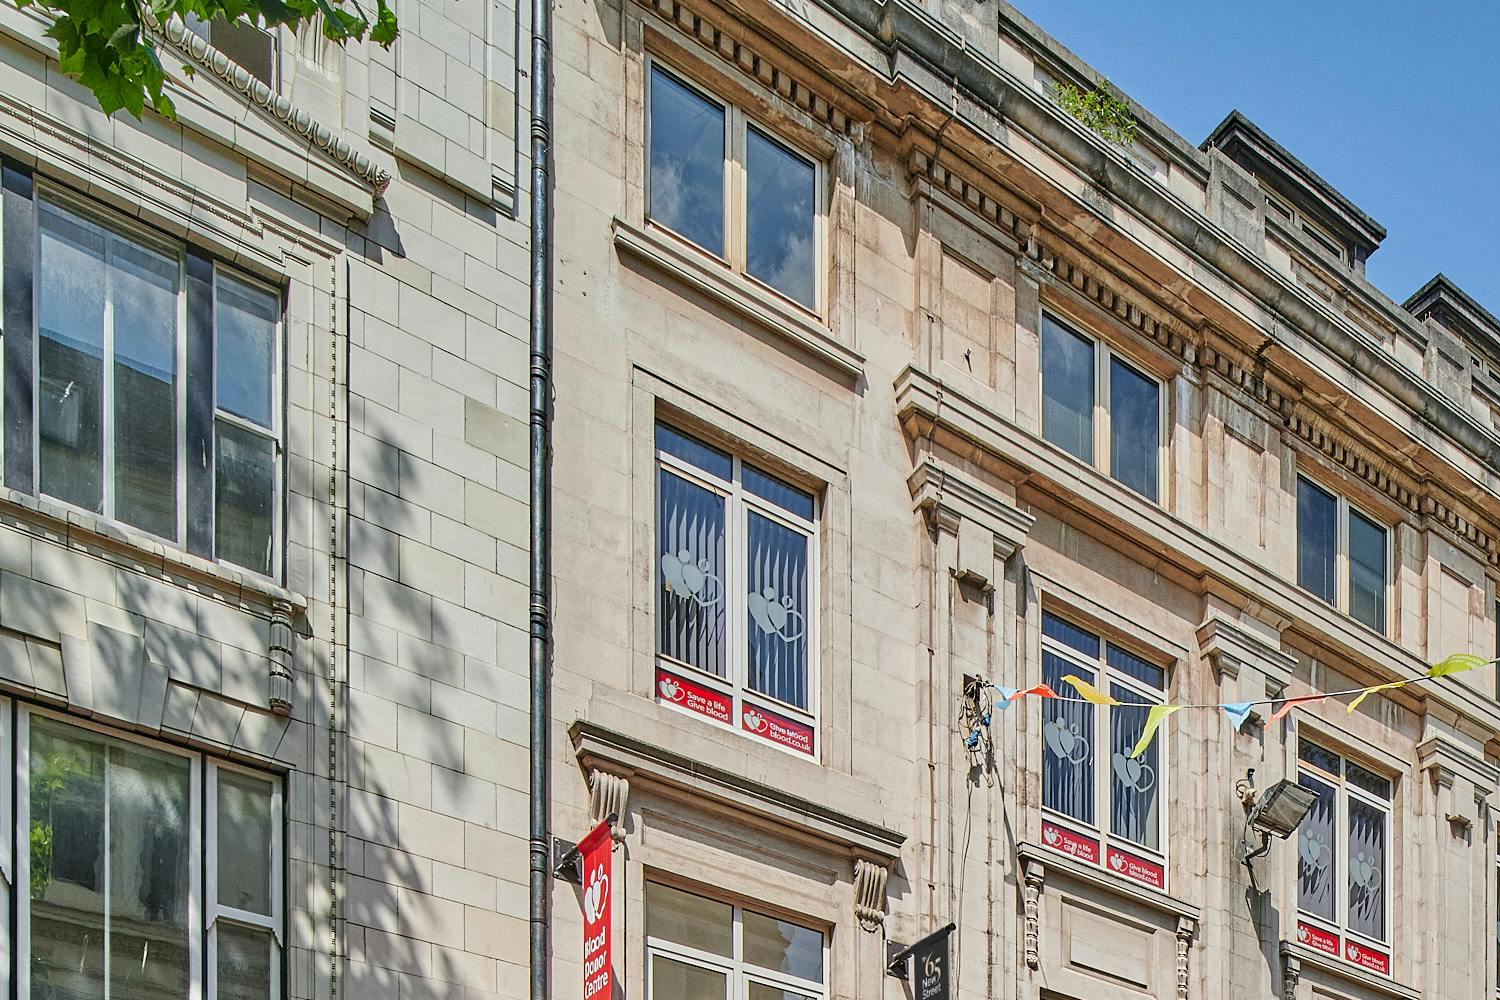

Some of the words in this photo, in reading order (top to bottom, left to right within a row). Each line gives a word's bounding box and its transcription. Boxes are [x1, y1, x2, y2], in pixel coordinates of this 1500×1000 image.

[687, 691, 706, 704] Save
[714, 700, 726, 712] life
[687, 700, 705, 711] Give
[706, 706, 729, 720] blood
[770, 723, 786, 734] Give
[770, 730, 811, 752] blood.co.uk
[585, 926, 605, 959] Blood
[585, 950, 607, 980] Donor
[925, 951, 941, 983] 65
[585, 972, 608, 999] Centre
[922, 976, 937, 989] New
[922, 984, 941, 1000] Street
